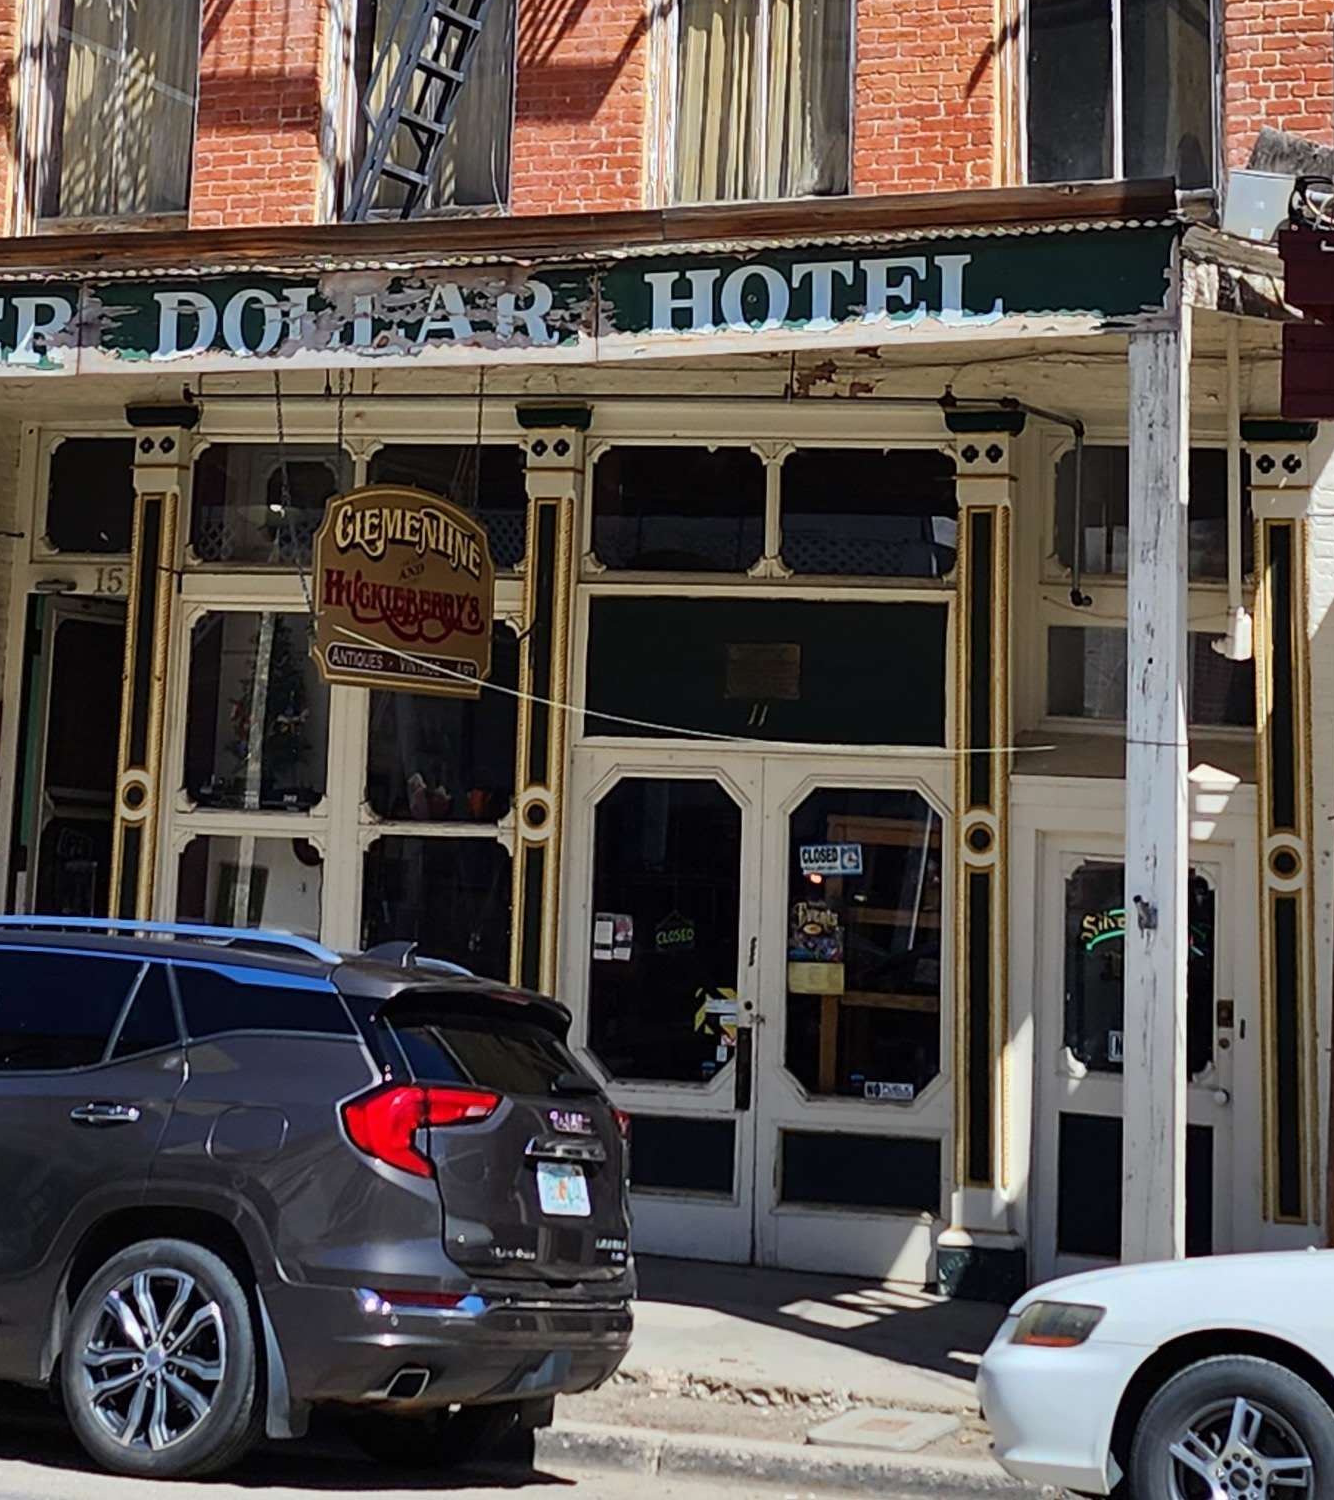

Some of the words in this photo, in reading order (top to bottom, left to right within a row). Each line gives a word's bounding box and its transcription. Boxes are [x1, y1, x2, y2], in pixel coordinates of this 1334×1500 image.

[644, 254, 1004, 333] HOTEL
[334, 504, 482, 577] CLEMENTINE
[331, 646, 384, 670] ANTIQUES
[802, 847, 838, 864] CLOSED
[655, 927, 695, 945] CLOSED
